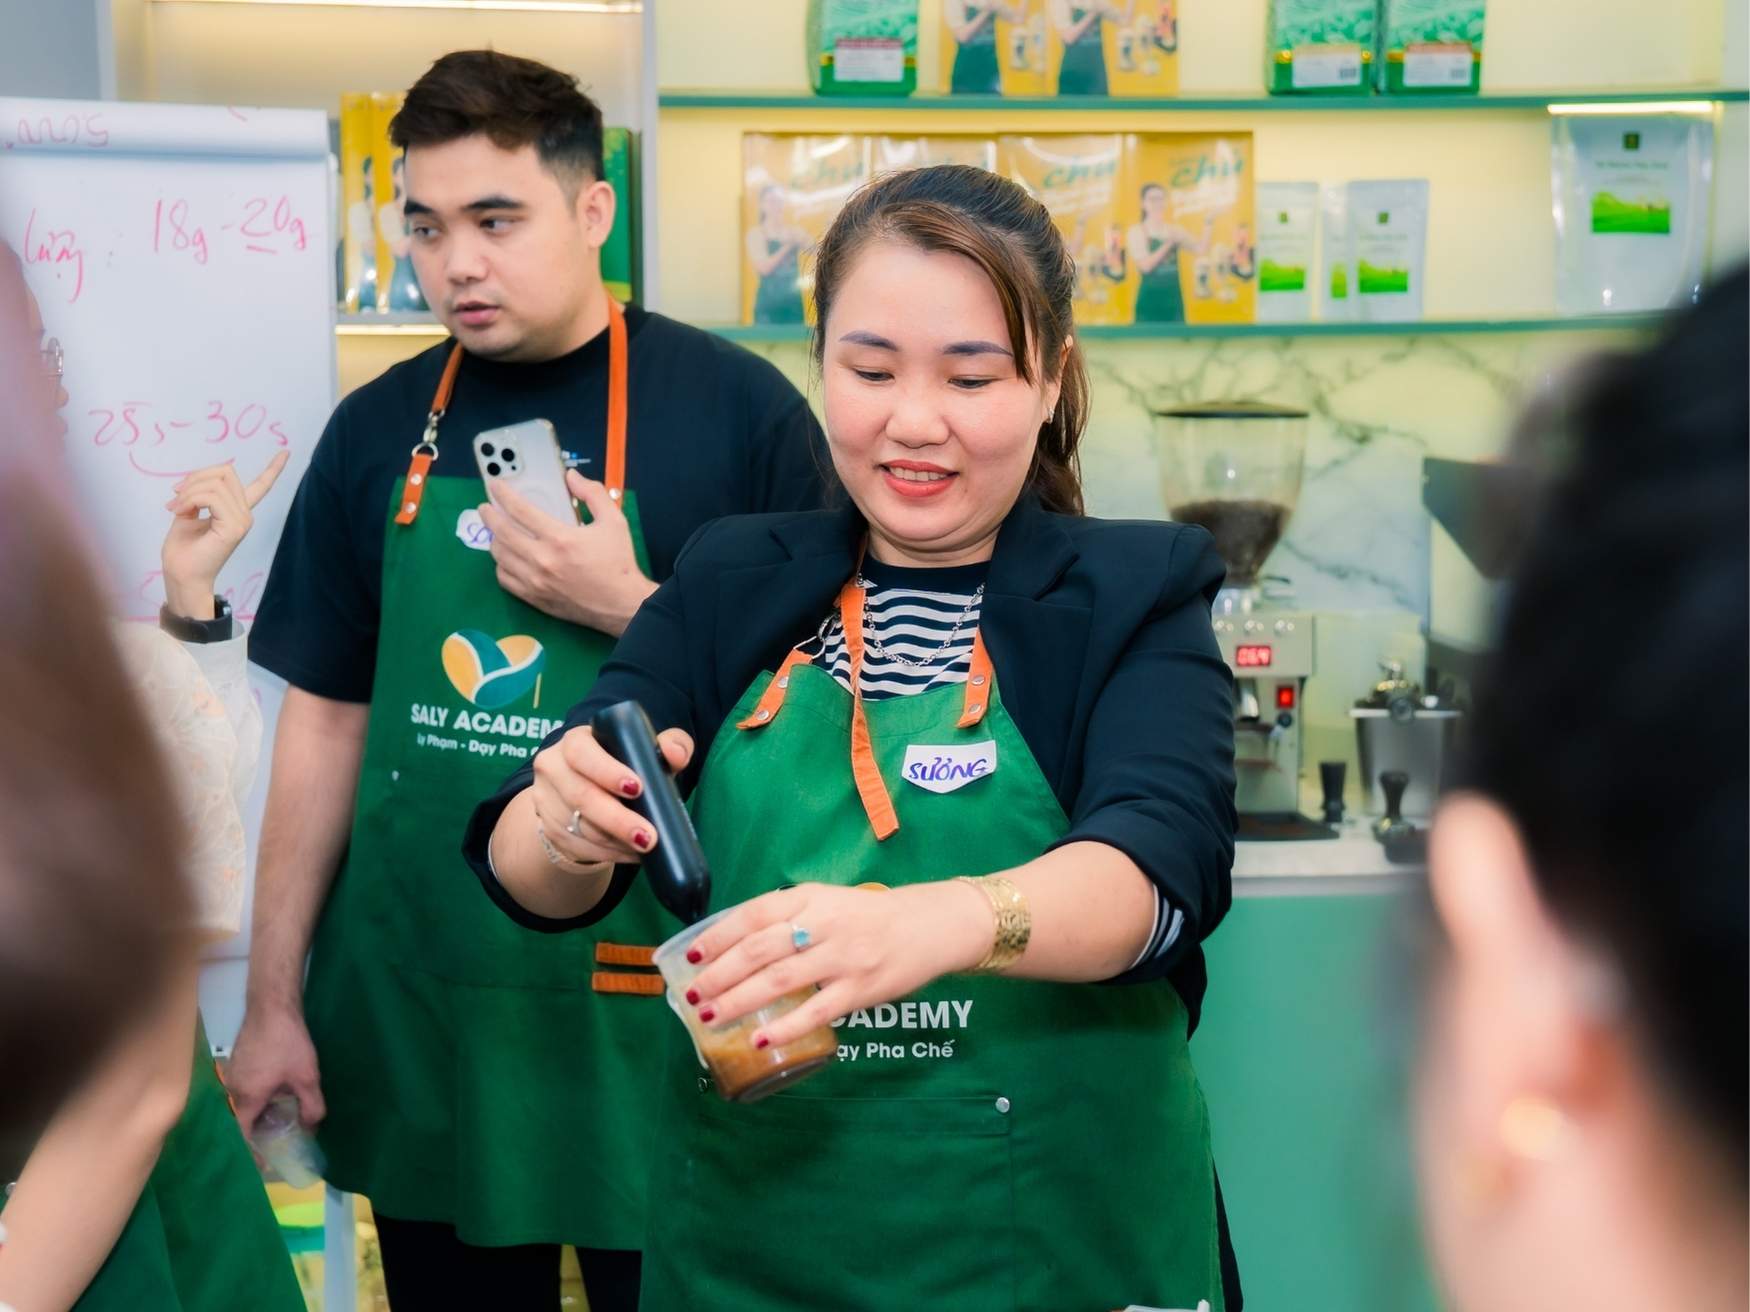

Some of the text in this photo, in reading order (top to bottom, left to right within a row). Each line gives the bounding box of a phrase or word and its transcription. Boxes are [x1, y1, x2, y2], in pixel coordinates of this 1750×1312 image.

[411, 703, 448, 727] SALY
[468, 739, 496, 756] Dạy
[499, 742, 528, 758] Pha
[866, 1042, 905, 1058] Pha
[911, 1039, 956, 1058] Chế
